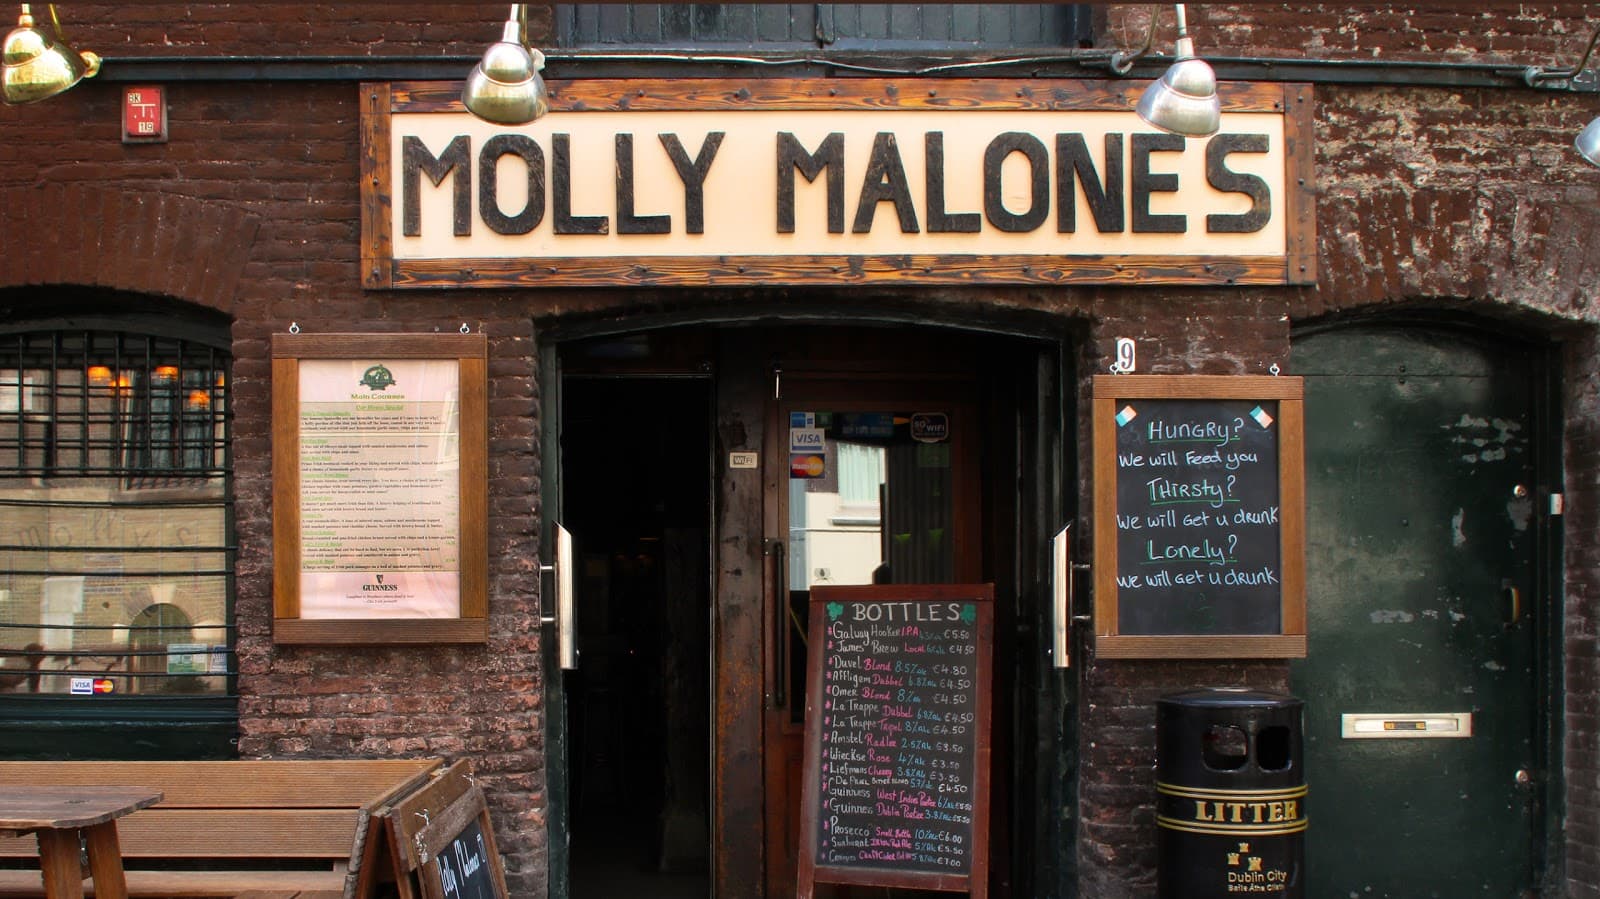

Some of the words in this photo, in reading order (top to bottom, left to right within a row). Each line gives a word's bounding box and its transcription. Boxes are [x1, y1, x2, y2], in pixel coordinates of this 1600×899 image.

[402, 132, 725, 236] MOLLY
[776, 131, 1272, 234] MALONES
[1121, 343, 1134, 369] 9
[795, 433, 821, 443] VISA
[1149, 451, 1178, 466] will
[1226, 453, 1258, 470] you
[1147, 510, 1176, 528] will
[1216, 516, 1229, 526] u
[1145, 570, 1172, 588] will
[1209, 574, 1220, 585] u
[852, 603, 961, 621] BOTTLES
[832, 621, 870, 646] Galway
[836, 639, 865, 653] James
[833, 655, 862, 669] Duvel
[864, 658, 892, 671] Blond
[933, 664, 968, 676] €4.80
[832, 698, 846, 712] La
[846, 698, 880, 718] Trappe
[932, 693, 968, 705] €4.50
[832, 714, 846, 728] La
[831, 730, 864, 744] Amstel
[828, 777, 871, 798] Guinness
[877, 788, 897, 801] West
[938, 784, 968, 793] €4.50
[1195, 800, 1298, 823] LITTER
[830, 815, 870, 836] Prosecco
[1227, 871, 1264, 883] Dublin
[1266, 869, 1288, 882] City
